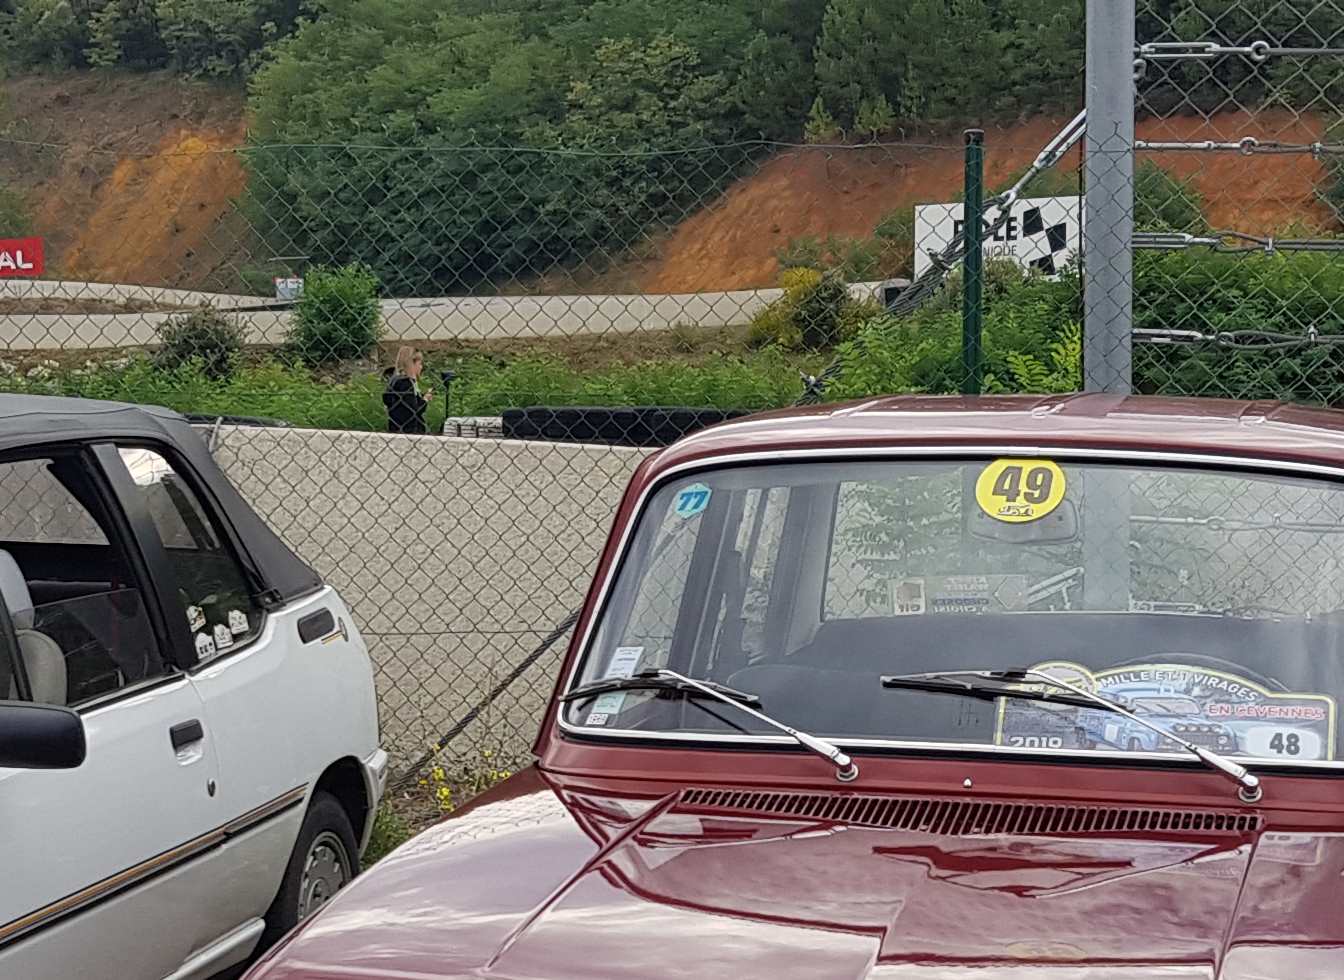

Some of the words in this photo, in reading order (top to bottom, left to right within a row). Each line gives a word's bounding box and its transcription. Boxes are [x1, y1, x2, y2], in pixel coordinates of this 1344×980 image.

[992, 465, 1054, 505] 49
[677, 490, 709, 511] 77
[1100, 671, 1150, 688] MILLE
[1156, 671, 1174, 681] ET
[1192, 673, 1259, 702] VIRAGES
[1209, 704, 1230, 715] EN
[1269, 732, 1300, 756] 48
